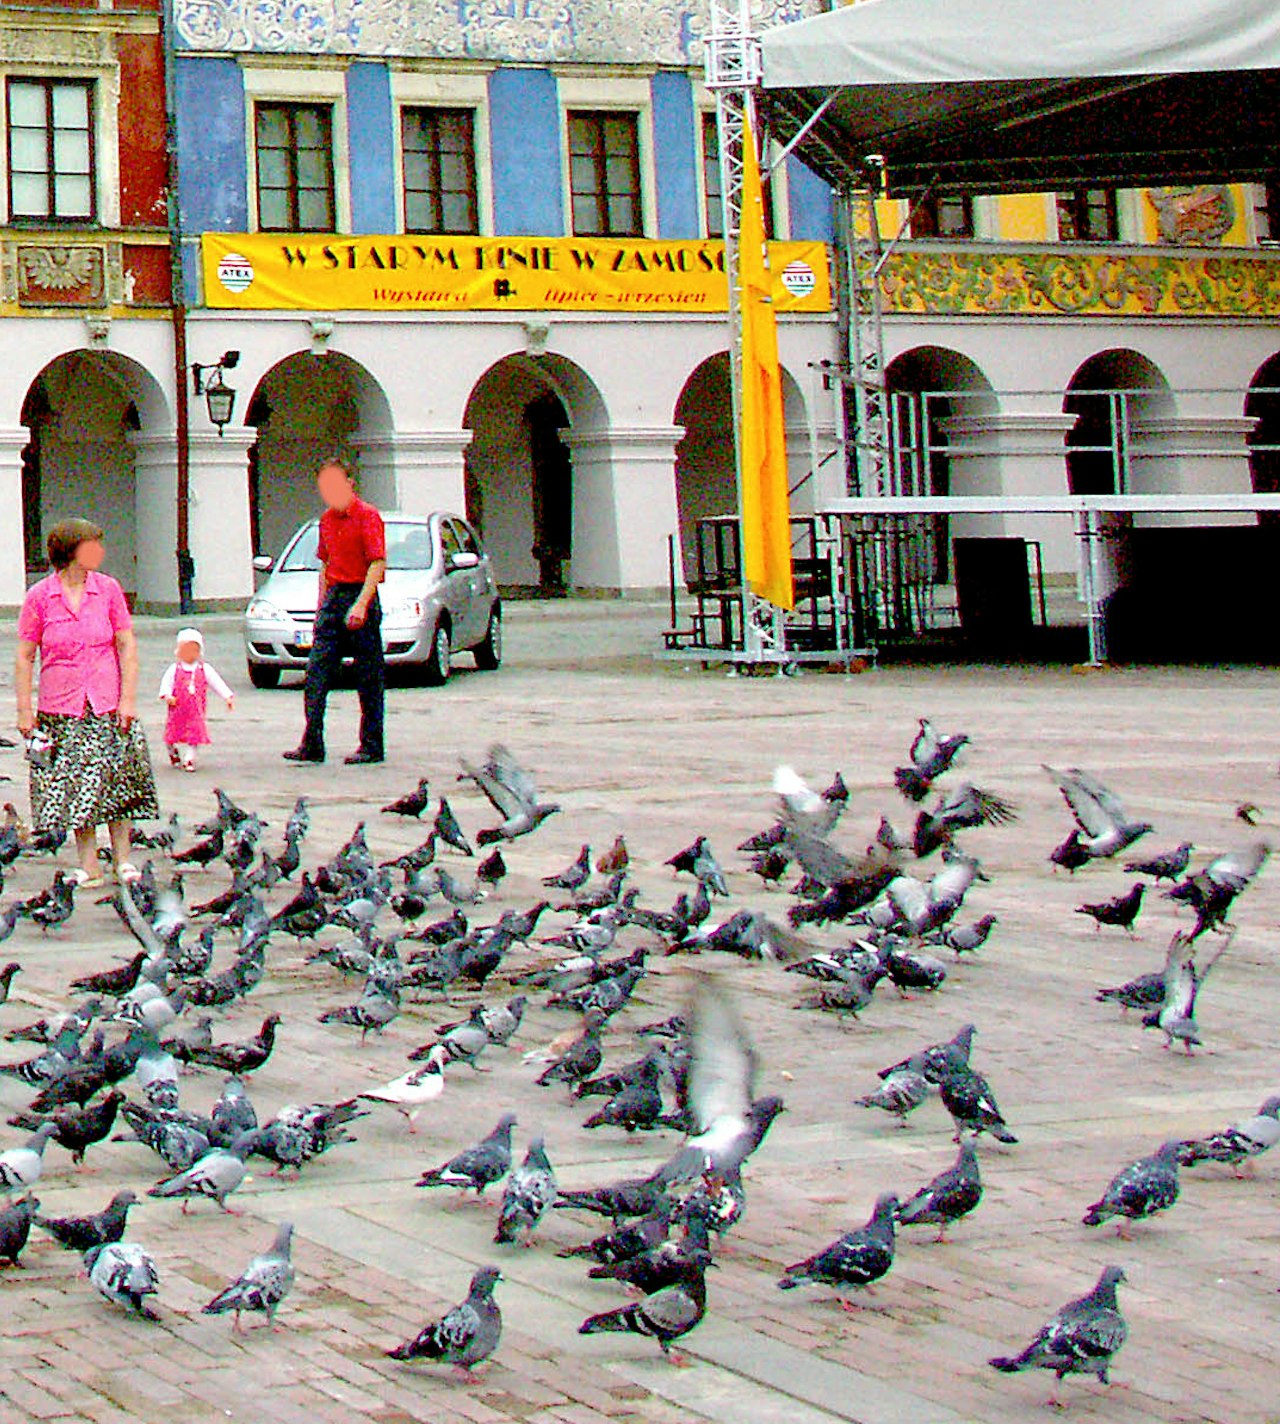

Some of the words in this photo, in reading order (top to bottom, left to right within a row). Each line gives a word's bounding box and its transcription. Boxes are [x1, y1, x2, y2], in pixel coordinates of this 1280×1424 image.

[282, 245, 309, 268] W
[322, 245, 459, 270] STARYM
[475, 245, 560, 272] KINIE
[570, 248, 597, 272] W
[611, 243, 728, 273] ZAMOŚC
[221, 268, 251, 277] ATEX
[785, 275, 812, 283] ATEX
[373, 288, 467, 304] Wystawa
[544, 288, 598, 304] lipiec
